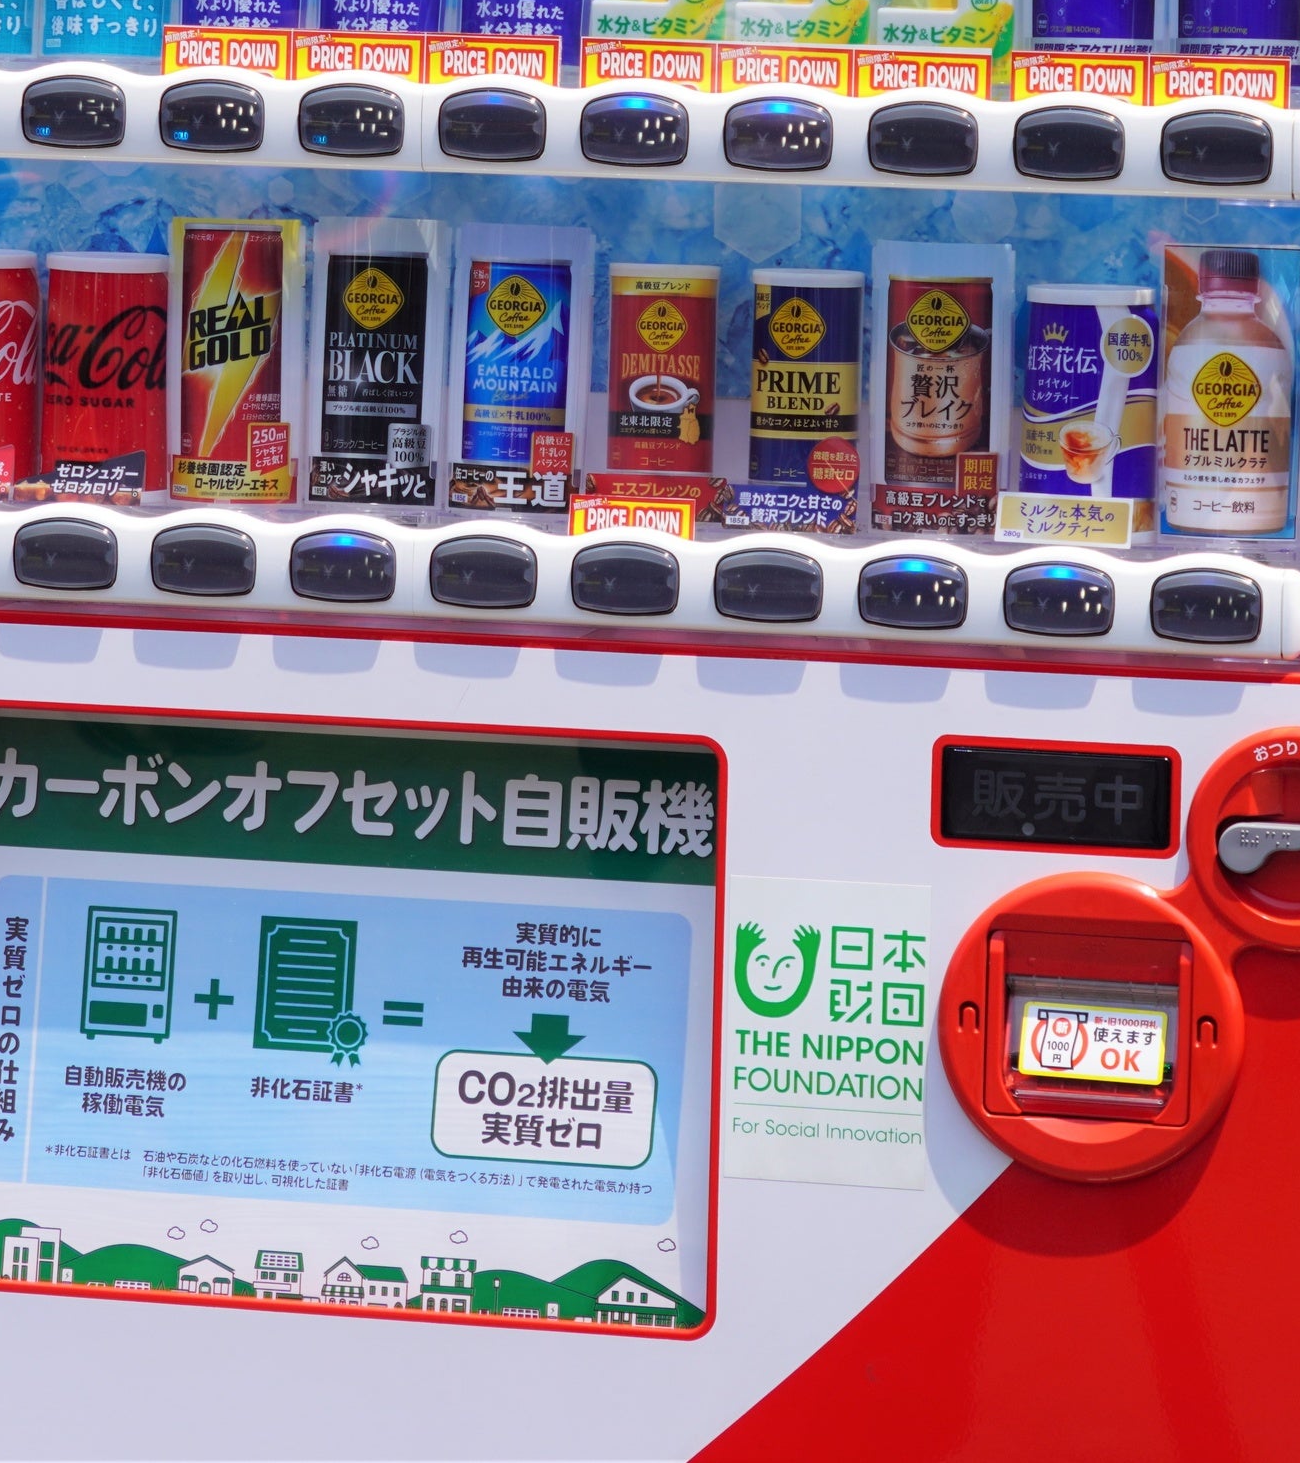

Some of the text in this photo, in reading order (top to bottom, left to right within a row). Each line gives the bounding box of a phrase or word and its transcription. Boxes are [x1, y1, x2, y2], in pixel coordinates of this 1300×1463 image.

[180, 40, 277, 67] PRICE DOWN
[347, 293, 399, 304] GEORGIA
[190, 291, 271, 341] REAL
[640, 321, 684, 330] GEORGIA
[190, 325, 271, 371] GOLD
[329, 332, 418, 349] PLATINUM
[328, 349, 420, 385] BLACK
[477, 364, 554, 379] EMERALD
[621, 353, 700, 379] DEMITASSE
[1027, 345, 1099, 375] 紅茶花伝
[473, 380, 558, 393] MOUNTAIN
[757, 369, 840, 395] PRIME
[911, 375, 960, 399] 贅沢
[1196, 381, 1258, 397] GEORGIA
[80, 397, 135, 408] SUGAR
[767, 396, 825, 411] BLEND
[900, 399, 973, 421] ブレイク
[620, 415, 673, 427] 北東北限定
[1184, 427, 1269, 453] THE LATTE
[56, 463, 139, 478] ゼロシュガー
[178, 461, 247, 476] 杉養蜂園認定
[343, 463, 426, 498] シャキッと
[52, 479, 138, 497] ゼロカロリー。
[195, 478, 278, 490] ローヤルゼリーエキス
[494, 471, 567, 508] 王道
[1020, 501, 1114, 523] ミルクに本気の
[1003, 529, 1021, 538] 280g
[1026, 516, 1105, 535] ミルクティー
[971, 768, 1145, 824] 販売中
[516, 922, 602, 948] 実質的に
[462, 946, 652, 977] 再生可能エネルギー
[502, 977, 610, 1003] 由来の電気
[735, 1029, 924, 1066] THE NIPPON
[1047, 1041, 1069, 1051] 1000
[1094, 1027, 1156, 1045] 使えます
[1101, 1048, 1141, 1072] OK
[64, 1065, 187, 1092] 自動販売機の
[734, 1066, 923, 1102] FOUNDATION
[82, 1092, 165, 1118] 稼働電気
[482, 1112, 602, 1150] 実質ゼロ
[732, 1117, 922, 1144] For Social Innovation
